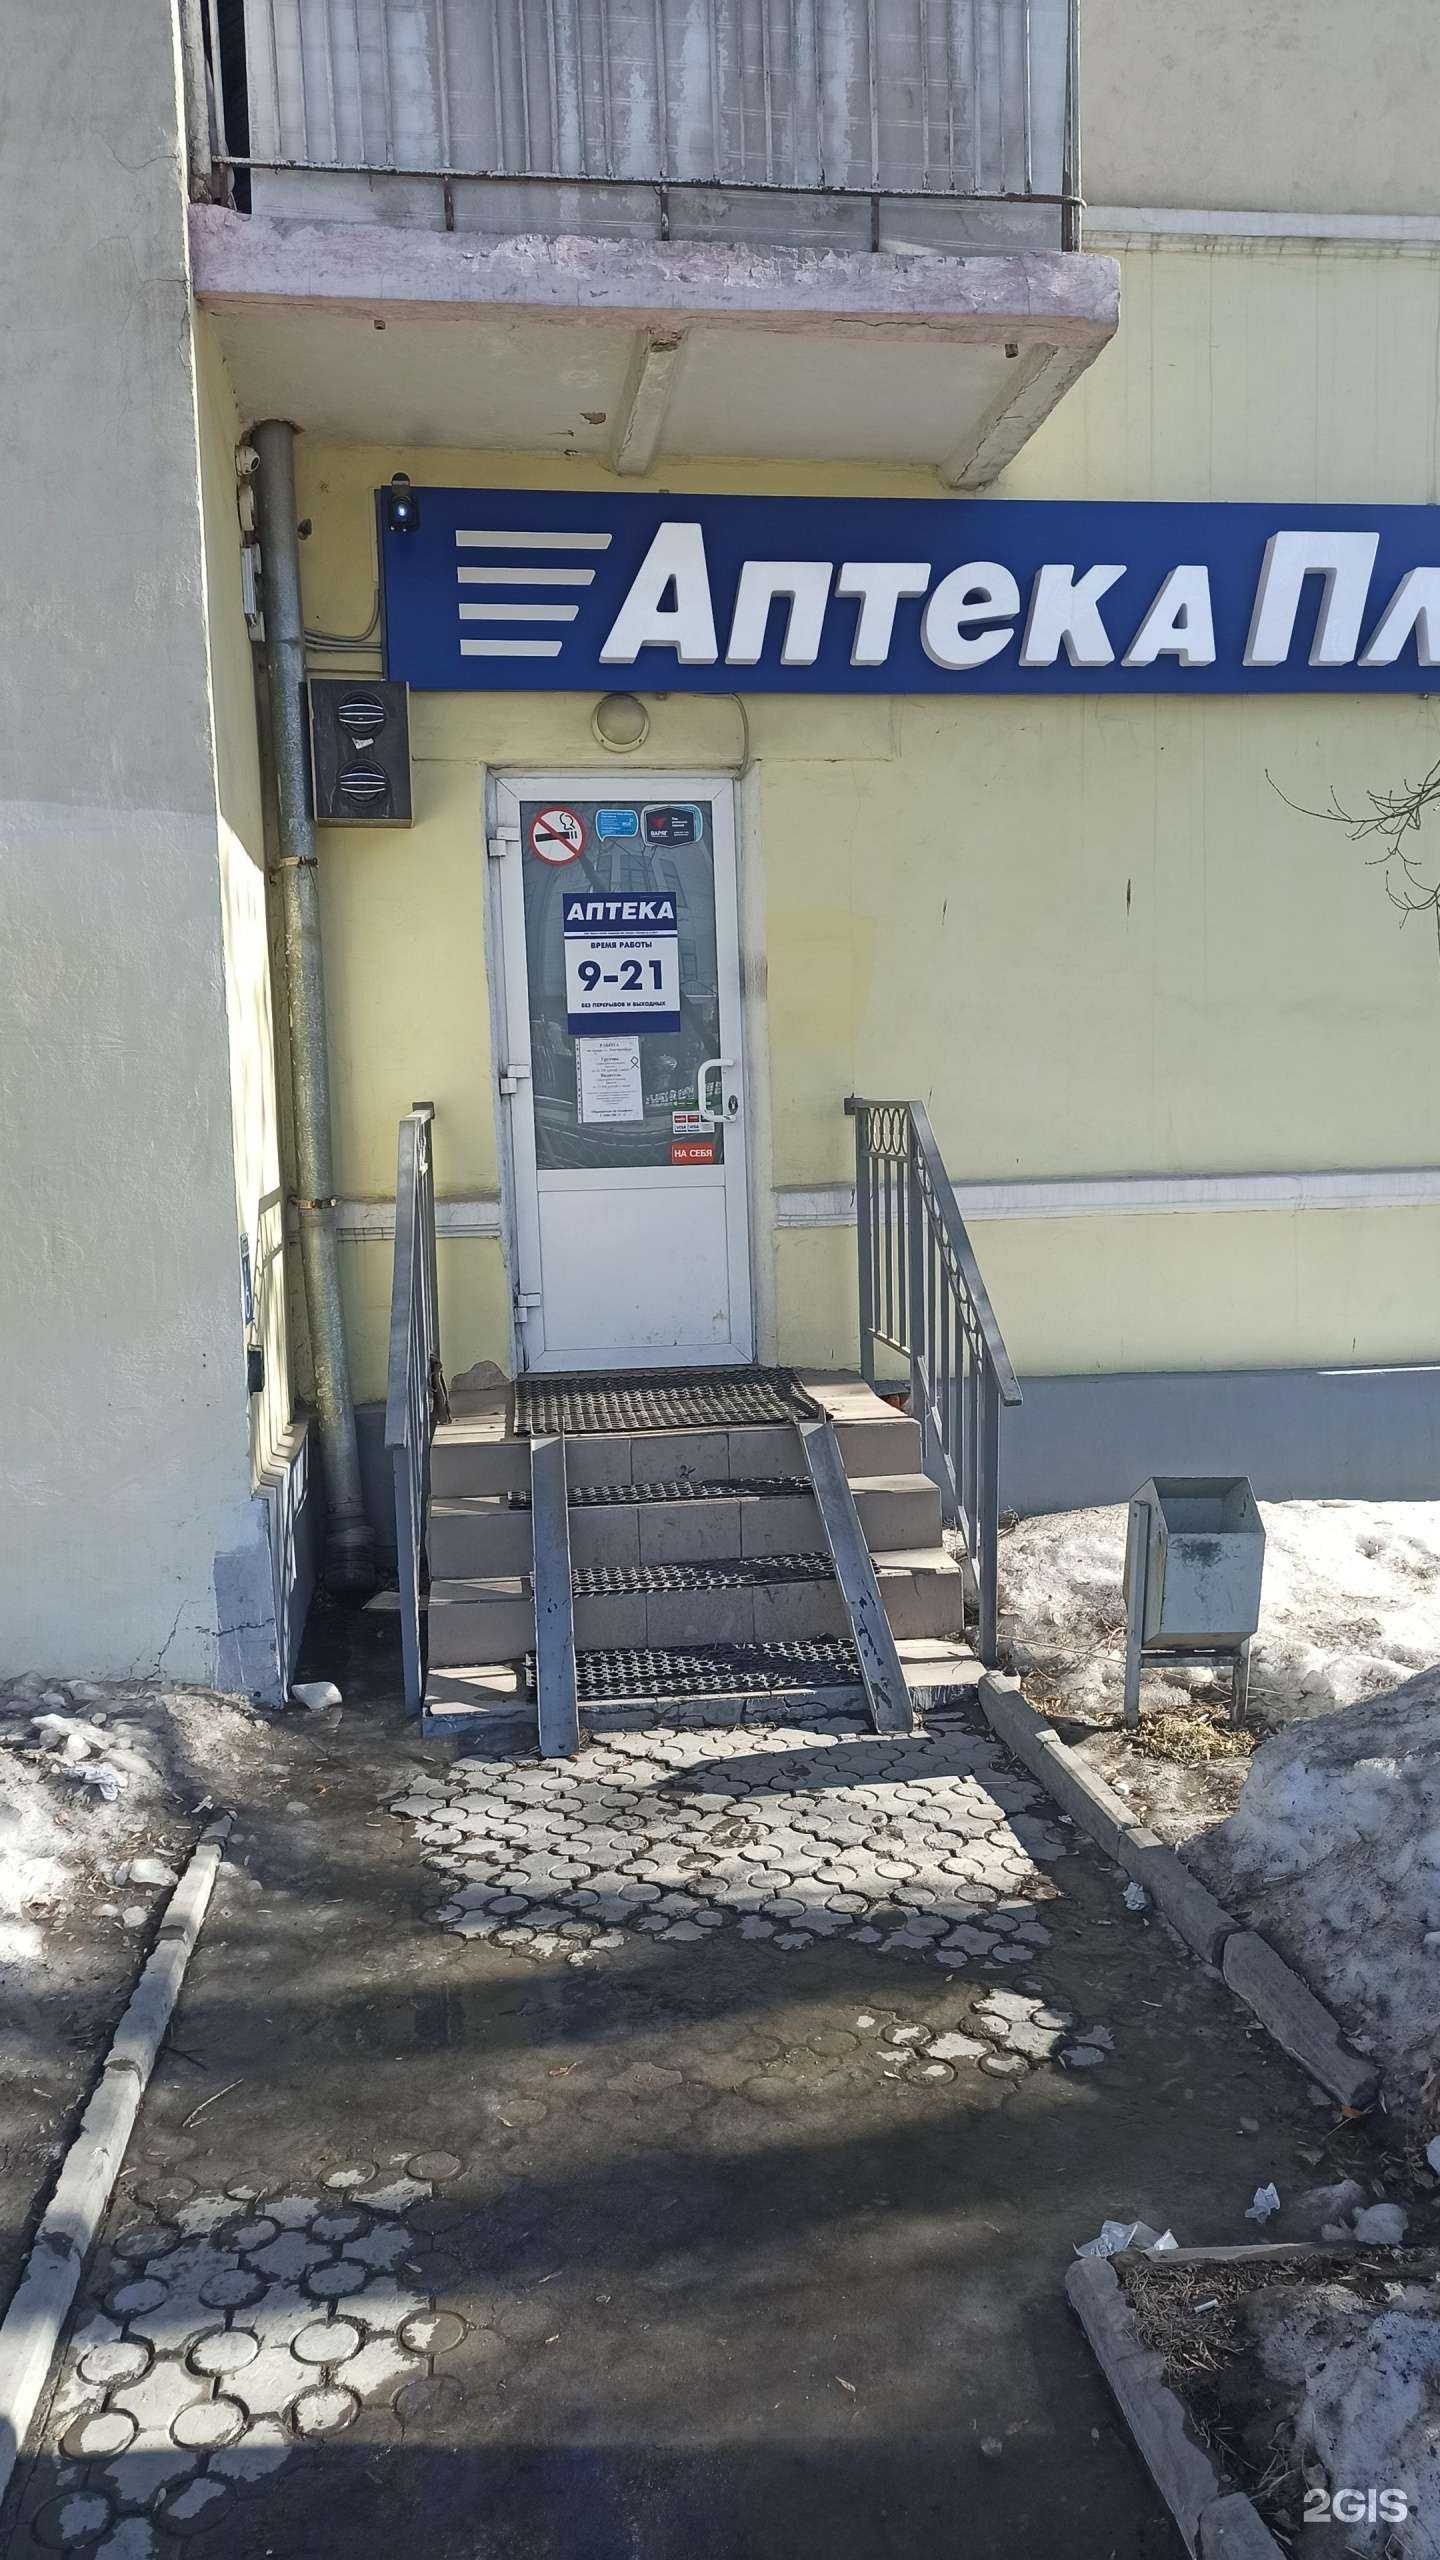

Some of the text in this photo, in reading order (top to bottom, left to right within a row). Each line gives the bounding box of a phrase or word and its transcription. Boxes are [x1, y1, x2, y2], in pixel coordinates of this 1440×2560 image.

[567, 901, 675, 921] АПТЕКА
[619, 941, 652, 949] РАБОТЫ
[577, 959, 663, 991] 9-21
[674, 1149, 713, 1158] НА СЕБЯ
